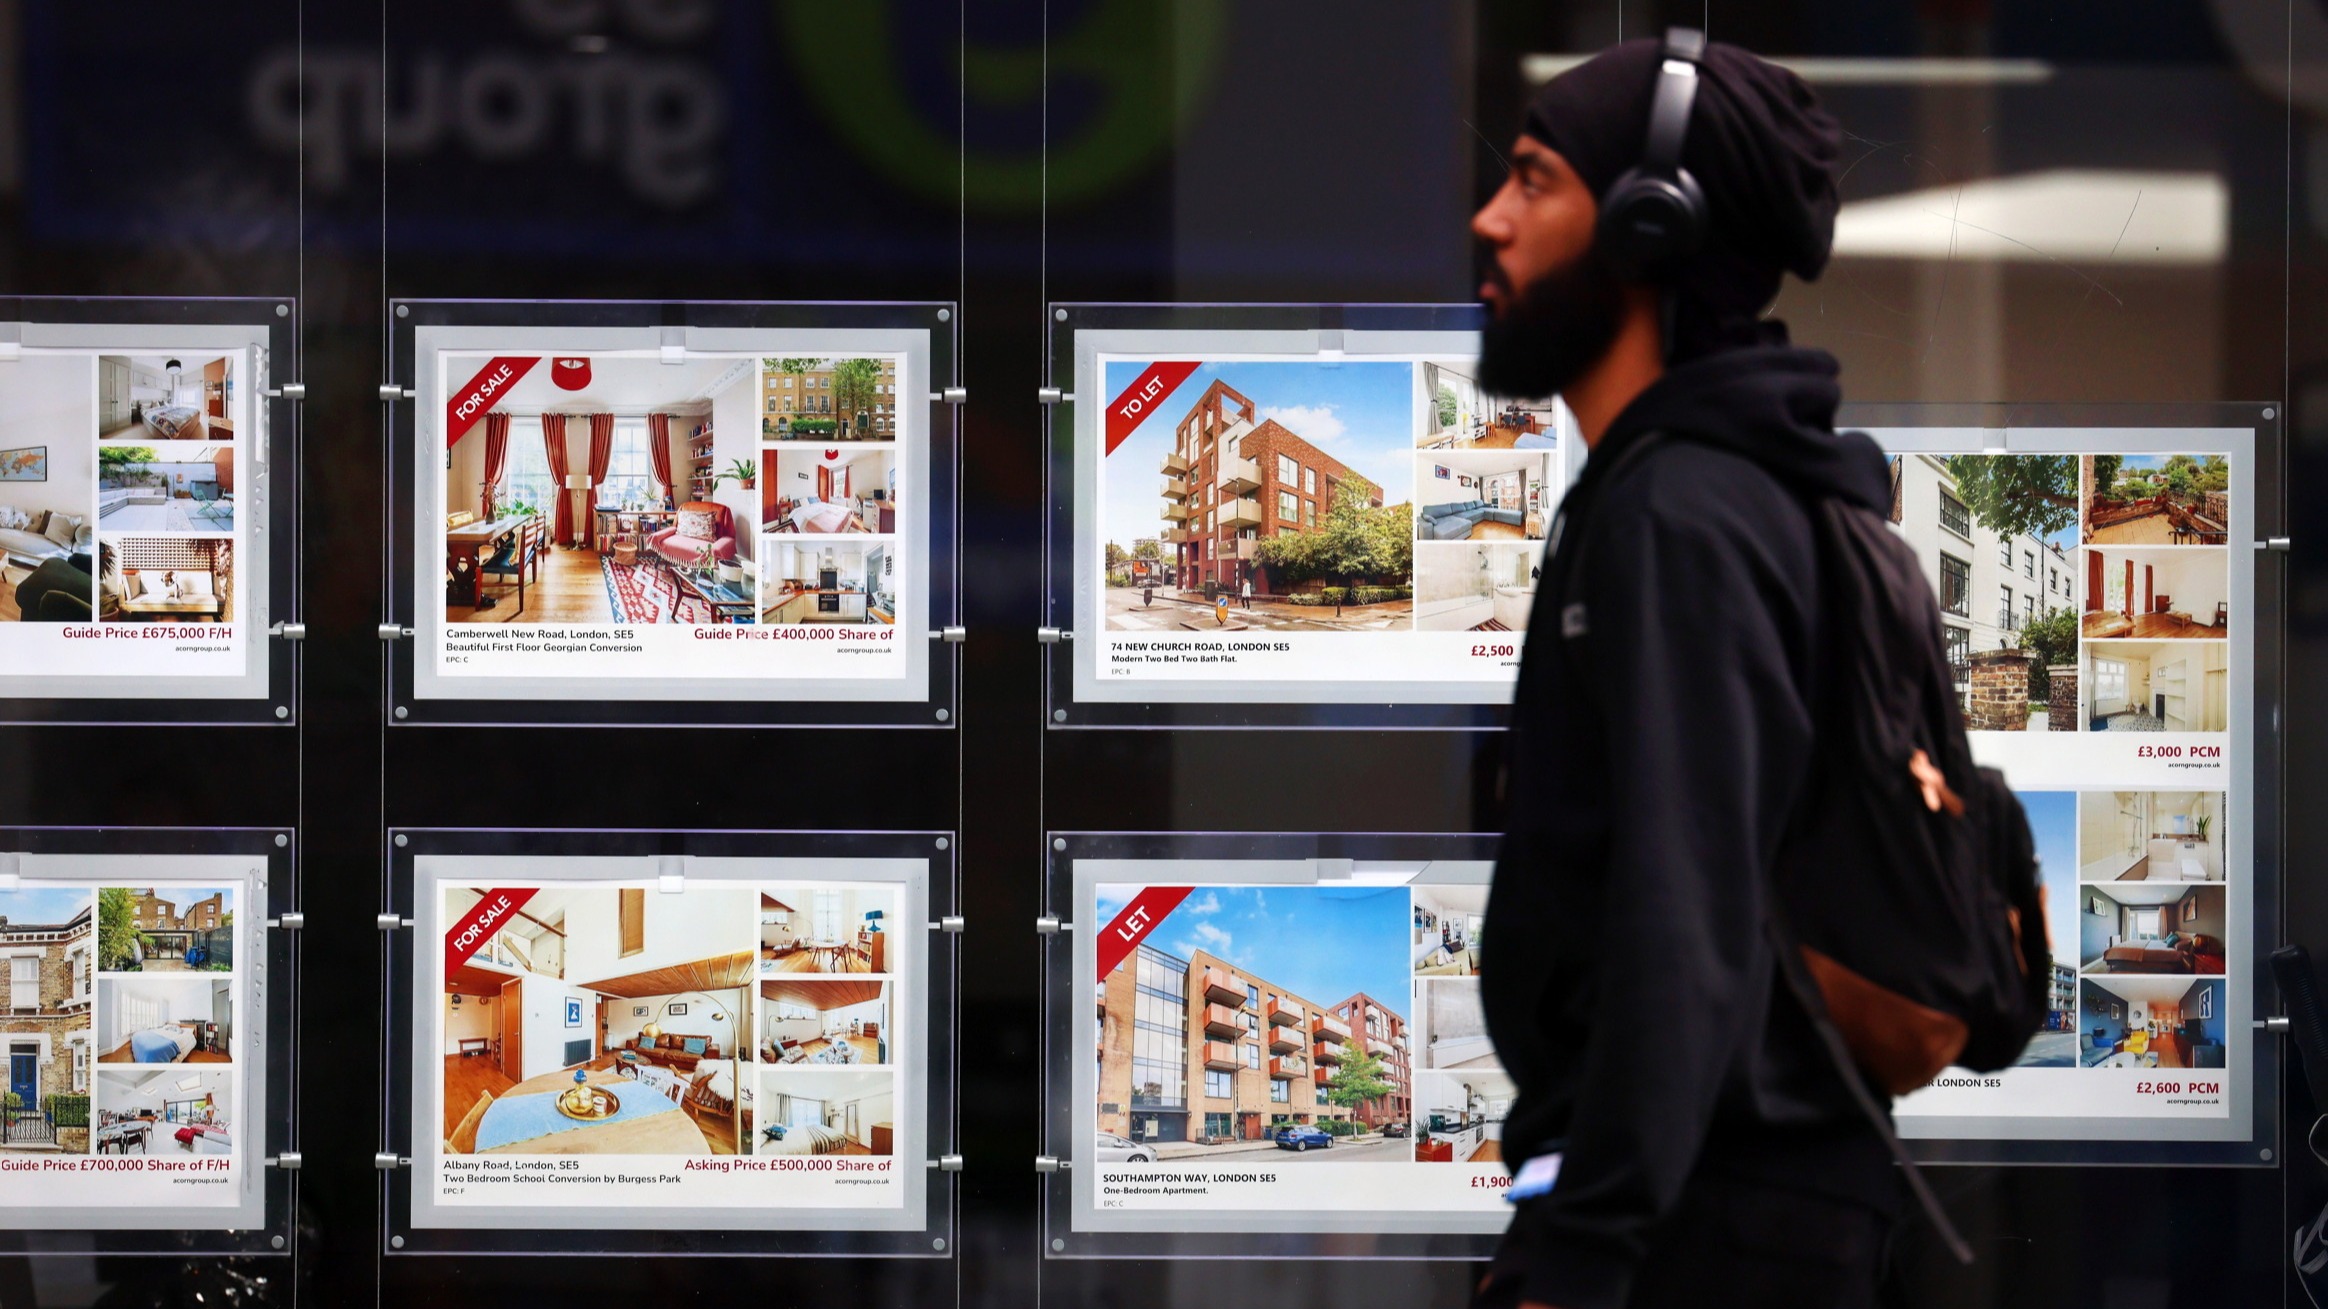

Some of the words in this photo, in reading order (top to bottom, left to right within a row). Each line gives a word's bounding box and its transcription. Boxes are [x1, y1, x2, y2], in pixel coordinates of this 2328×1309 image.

[455, 393, 485, 420] FOR
[480, 364, 513, 397] SALE
[1120, 400, 1143, 419] TO
[1143, 375, 1164, 402] LET
[62, 626, 102, 639] Guide
[105, 626, 139, 639] Price
[142, 626, 205, 640] £675,000
[209, 626, 232, 640] F/H
[446, 628, 509, 640] Camberwell
[511, 629, 536, 639] New
[537, 629, 567, 640] Road,
[570, 629, 611, 640] London,
[613, 629, 634, 639] SE5
[694, 627, 733, 640] Guide
[736, 627, 769, 640] Price
[772, 627, 835, 641] £400,000
[838, 628, 877, 641] Share
[879, 628, 894, 641] of
[175, 645, 231, 654] acorngroup.co.uk
[446, 642, 490, 652] Beautiful
[492, 642, 514, 652] First
[516, 642, 542, 652] Floor
[543, 642, 587, 654] Georgian
[589, 642, 643, 653] Conversion
[836, 646, 892, 655] acorngroup.co.uk
[1111, 642, 1123, 652] 74
[1125, 642, 1149, 652] NEW
[1150, 642, 1192, 652] CHURCH
[1194, 642, 1225, 653] ROAD,
[1227, 642, 1271, 652] LONDON
[1273, 642, 1290, 652] SE5
[1471, 644, 1514, 658] £2,500
[445, 656, 462, 664] EPC:
[463, 656, 469, 664] C
[1111, 654, 1143, 663] Modern
[1144, 654, 1162, 663] Two
[1163, 654, 1180, 663] Bed
[1180, 654, 1199, 663] Two
[1200, 654, 1219, 663] Bath
[1220, 654, 1238, 663] Flat.
[2137, 745, 2182, 759] £3,000
[2189, 745, 2221, 758] PCM
[2167, 762, 2221, 770] acorngroup.co.uk
[454, 923, 483, 952] FOR
[479, 895, 512, 928] SALE
[1117, 905, 1150, 942] LET
[1936, 1078, 1982, 1088] LONDON
[1983, 1078, 2001, 1088] SE5
[2136, 1081, 2181, 1096] £2,600
[2188, 1082, 2220, 1095] PCM
[2166, 1098, 2220, 1106] acorngroup.co.uk
[1, 1159, 40, 1172] Guide
[43, 1159, 77, 1172] Price
[80, 1158, 144, 1173] £700,000
[147, 1159, 186, 1171] Share
[189, 1159, 204, 1171] of
[206, 1158, 230, 1172] F/H
[443, 1160, 481, 1172] Albany
[483, 1160, 513, 1171] Road,
[515, 1160, 556, 1171] London,
[559, 1160, 580, 1170] SE5
[684, 1159, 730, 1173] Asking
[733, 1159, 767, 1171] Price
[770, 1159, 833, 1173] £500,000
[836, 1159, 875, 1172] Share
[877, 1159, 892, 1172] of
[172, 1176, 229, 1185] acorngroup.co.uk
[443, 1173, 465, 1183] Two
[466, 1173, 511, 1183] Bedroom
[513, 1173, 546, 1183] School
[547, 1173, 602, 1184] Conversion
[603, 1174, 616, 1185] by
[618, 1174, 657, 1185] Burgess
[659, 1174, 681, 1184] Park
[834, 1177, 890, 1186] acorngroup.co.uk
[1103, 1173, 1182, 1183] SOUTHAMPTON
[1183, 1173, 1210, 1184] WAY,
[1213, 1173, 1257, 1183] LONDON
[1259, 1173, 1277, 1183] SE5
[1470, 1175, 1514, 1190] £1,900
[442, 1187, 459, 1195] EPC:
[460, 1187, 465, 1195] F
[1103, 1186, 1161, 1195] One-Bedroom
[1162, 1186, 1209, 1197] Apartment.
